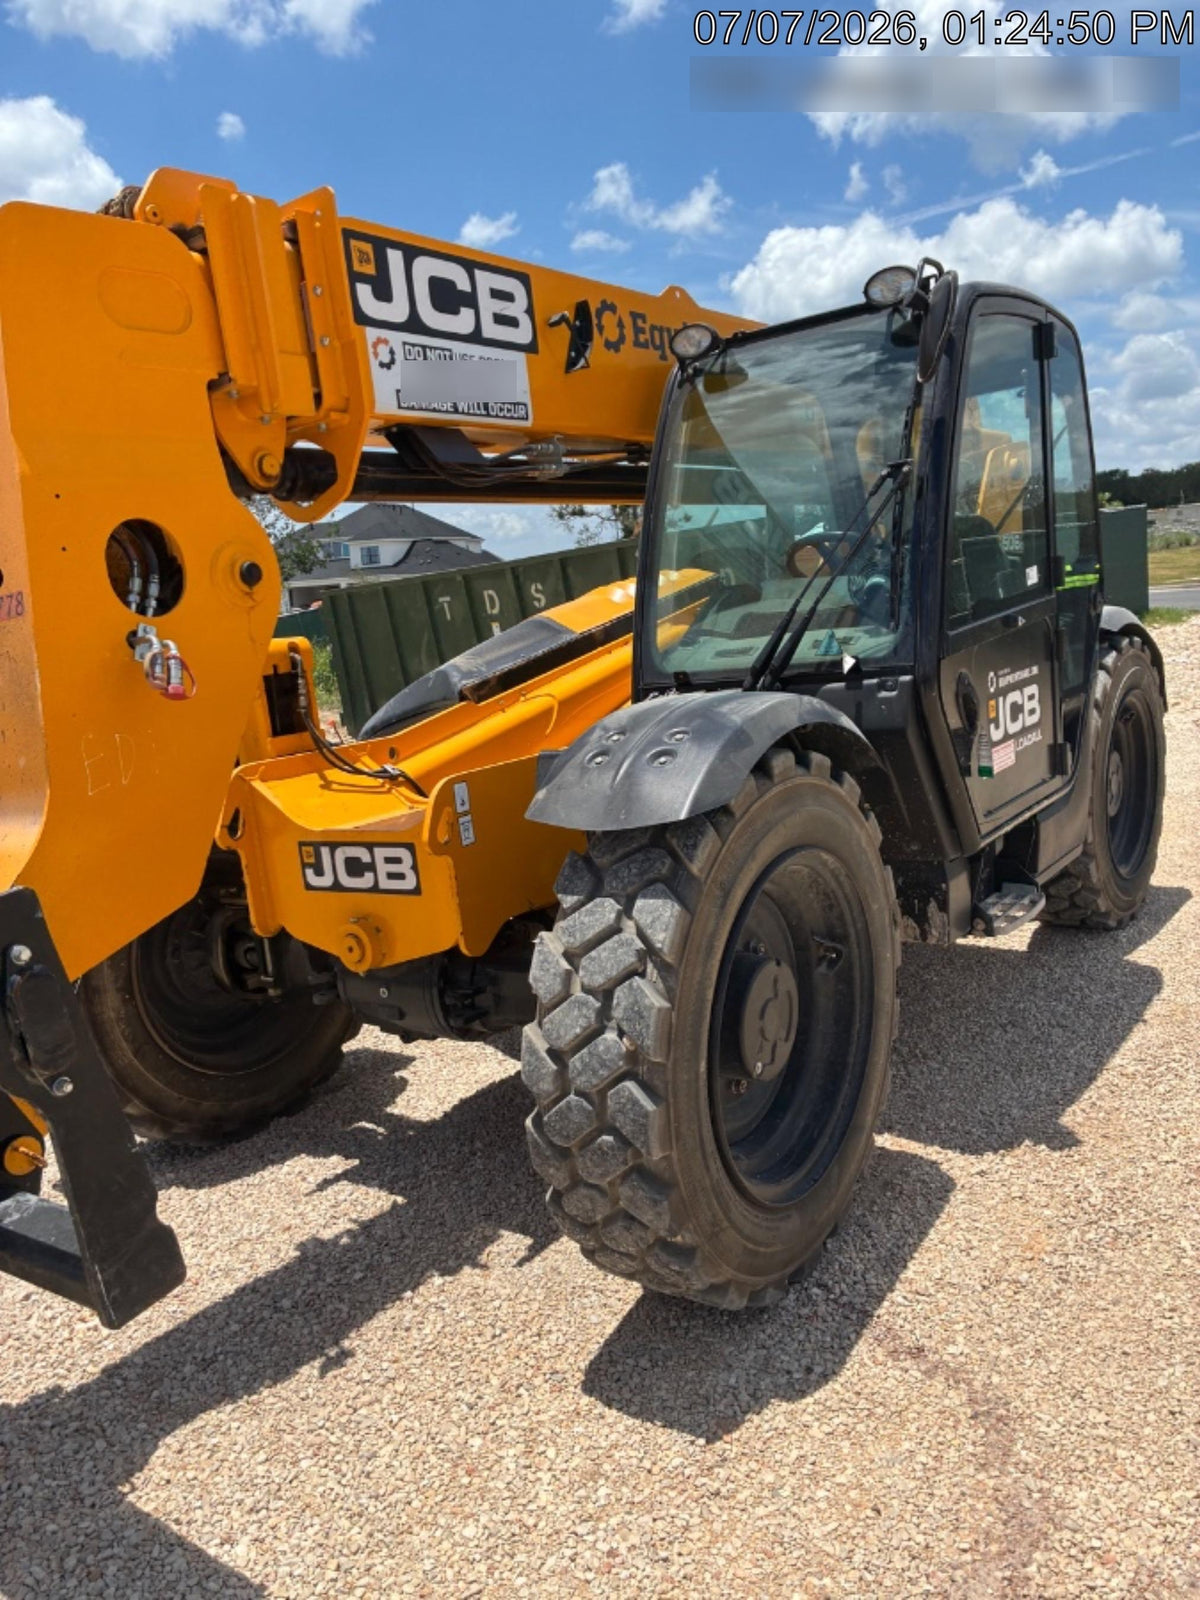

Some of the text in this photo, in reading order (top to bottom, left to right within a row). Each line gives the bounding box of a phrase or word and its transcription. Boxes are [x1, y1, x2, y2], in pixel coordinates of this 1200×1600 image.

[355, 247, 534, 345] JCB
[404, 344, 424, 361] DO
[457, 401, 487, 415] WILL
[488, 402, 527, 418] OCCUR
[990, 684, 1041, 741] JCB
[305, 846, 417, 890] JCB
